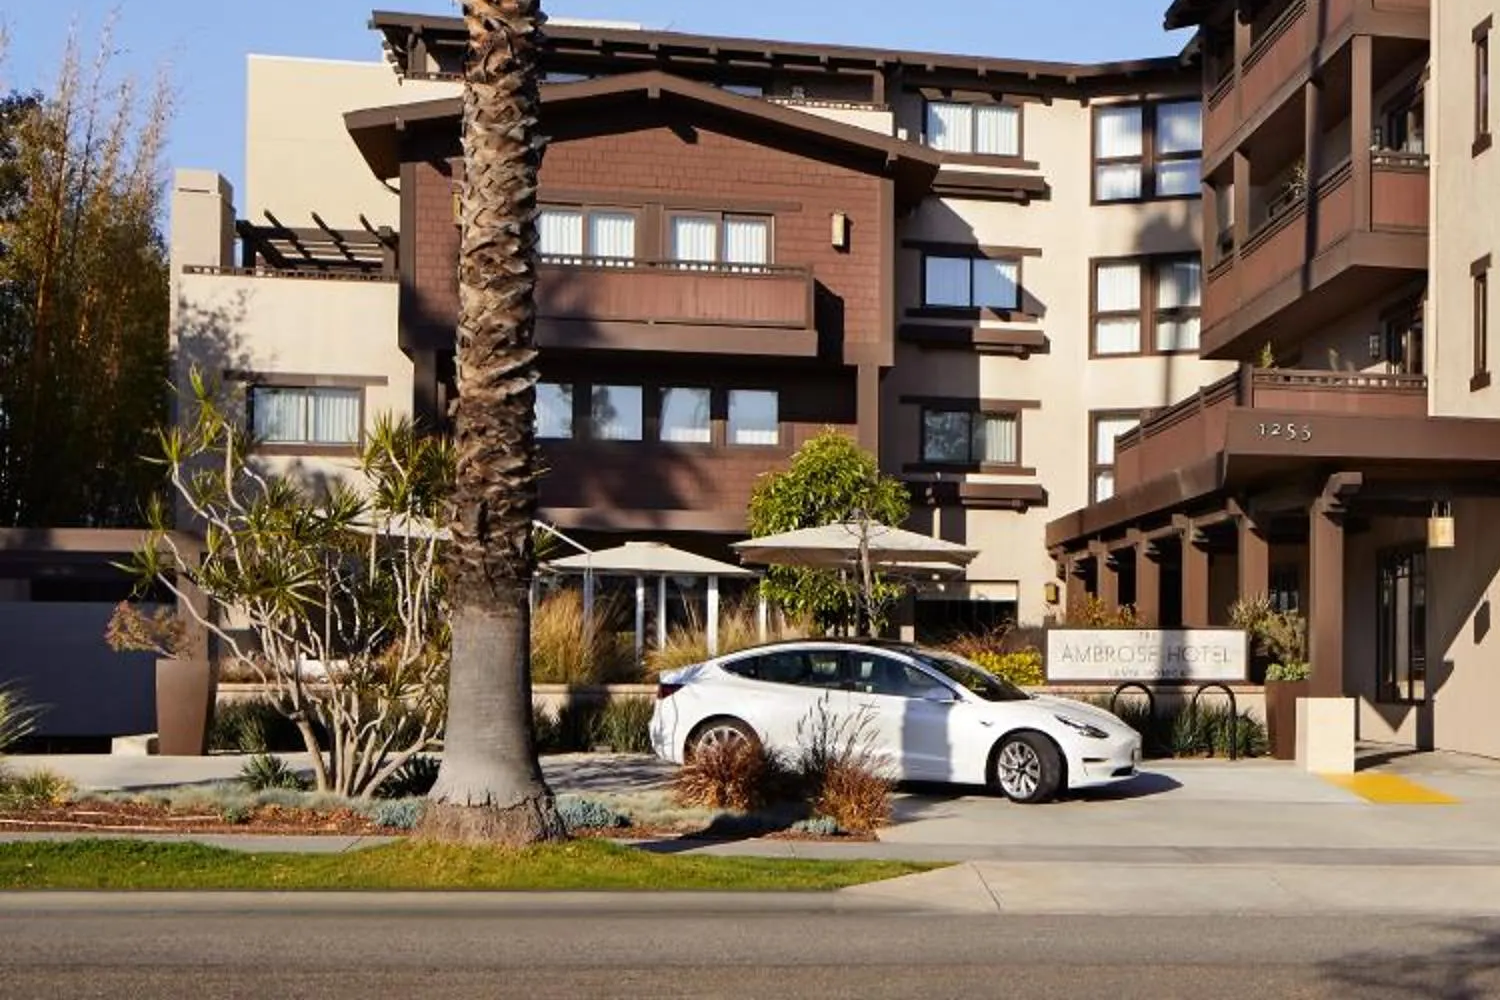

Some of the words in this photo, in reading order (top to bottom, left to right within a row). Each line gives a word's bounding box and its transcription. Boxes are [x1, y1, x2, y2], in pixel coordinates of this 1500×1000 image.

[1259, 423, 1312, 442] 1255
[1061, 644, 1158, 663] AMBROSE
[1166, 644, 1232, 663] HOTEL
